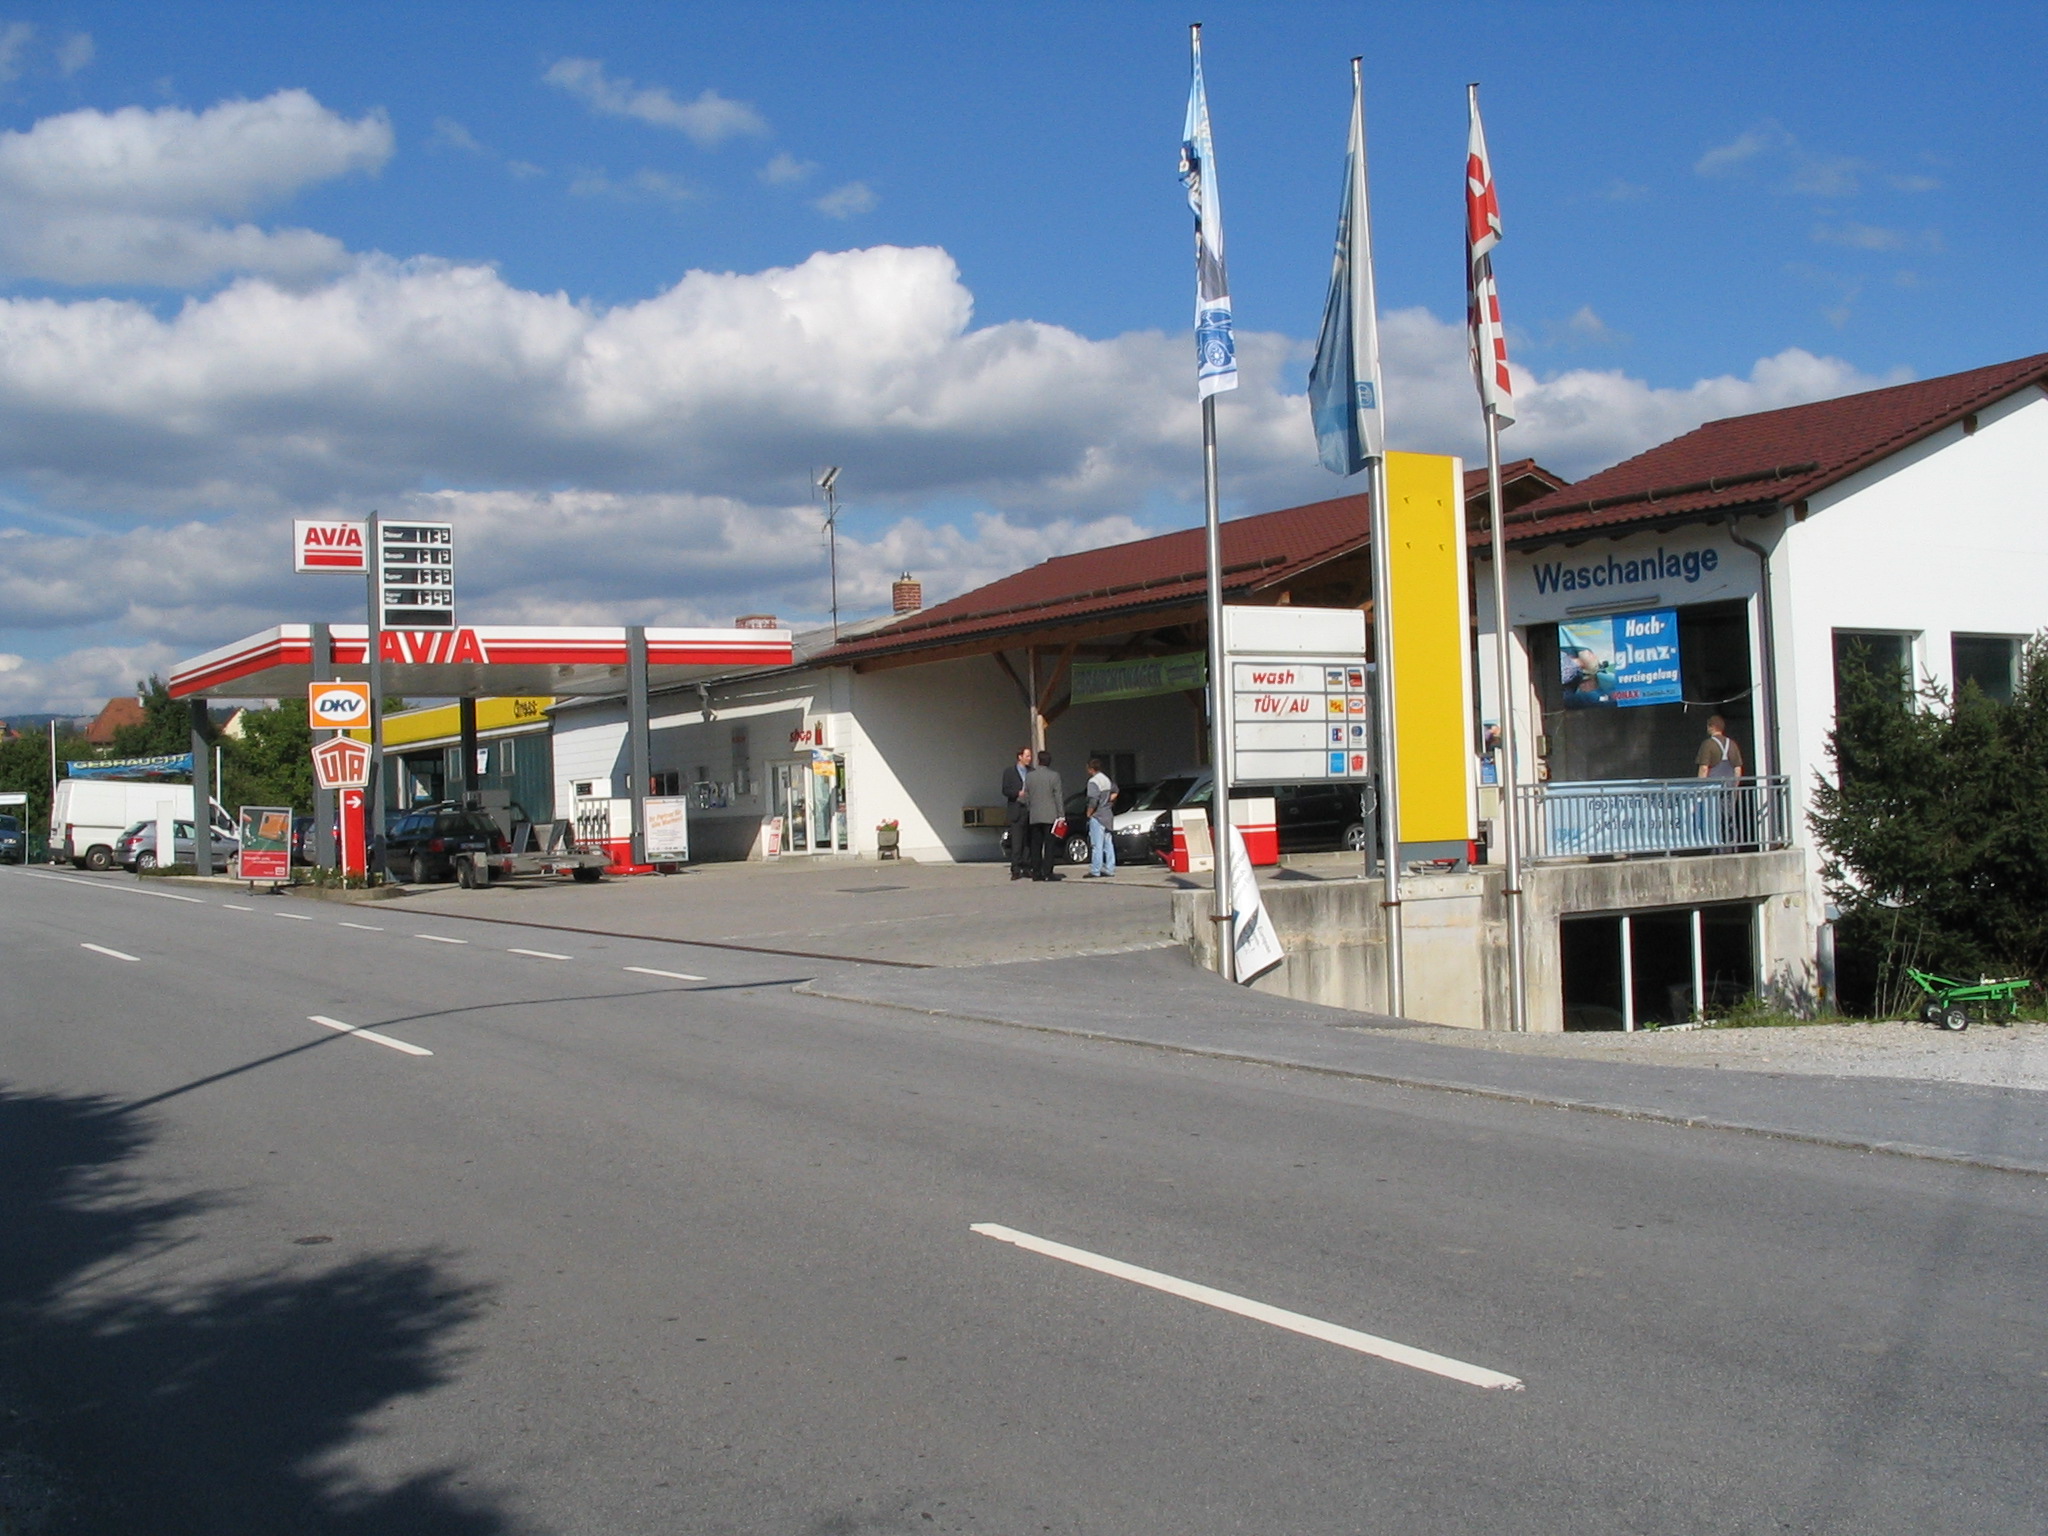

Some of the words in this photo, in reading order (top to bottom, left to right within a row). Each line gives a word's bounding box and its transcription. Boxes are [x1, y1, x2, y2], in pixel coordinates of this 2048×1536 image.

[304, 523, 363, 547] AVIA
[1533, 547, 1718, 595] Waschanlage
[1625, 615, 1665, 637] Hoch-
[379, 629, 487, 664] AVIA
[1615, 643, 1677, 670] glanz-
[1252, 670, 1295, 684] wash
[1618, 669, 1679, 685] versiegelung
[319, 699, 362, 713] DKV
[789, 728, 812, 745] shop
[319, 743, 366, 783] UTA
